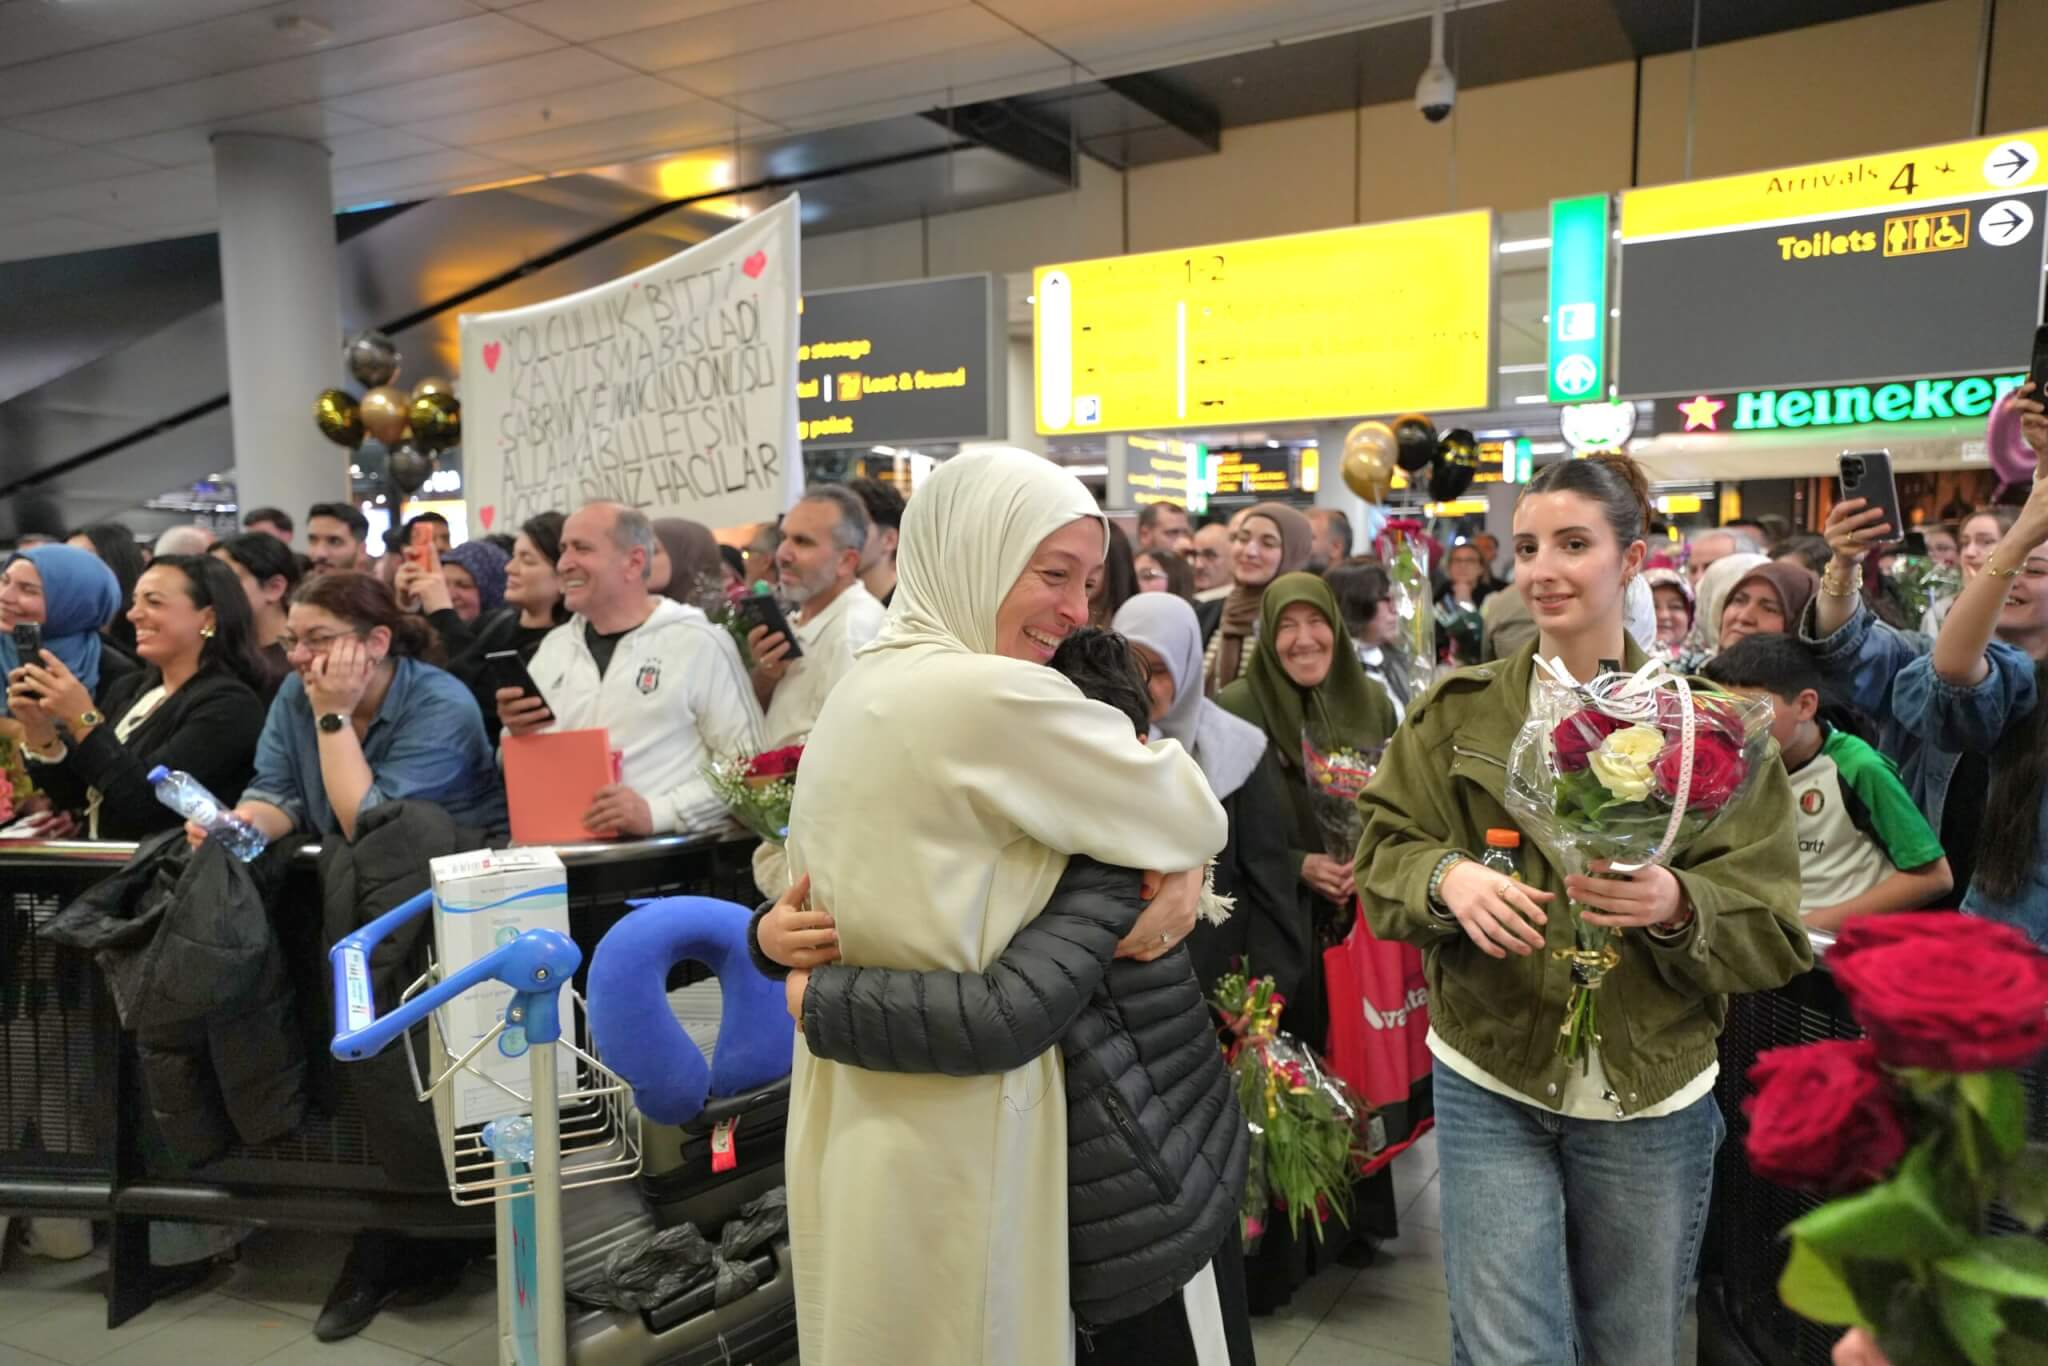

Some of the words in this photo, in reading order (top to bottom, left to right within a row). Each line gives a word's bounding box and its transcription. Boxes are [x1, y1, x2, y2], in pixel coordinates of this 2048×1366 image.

[1766, 163, 1878, 194] Arrivals
[1889, 162, 1919, 195] 4
[1776, 230, 1877, 261] Toilets
